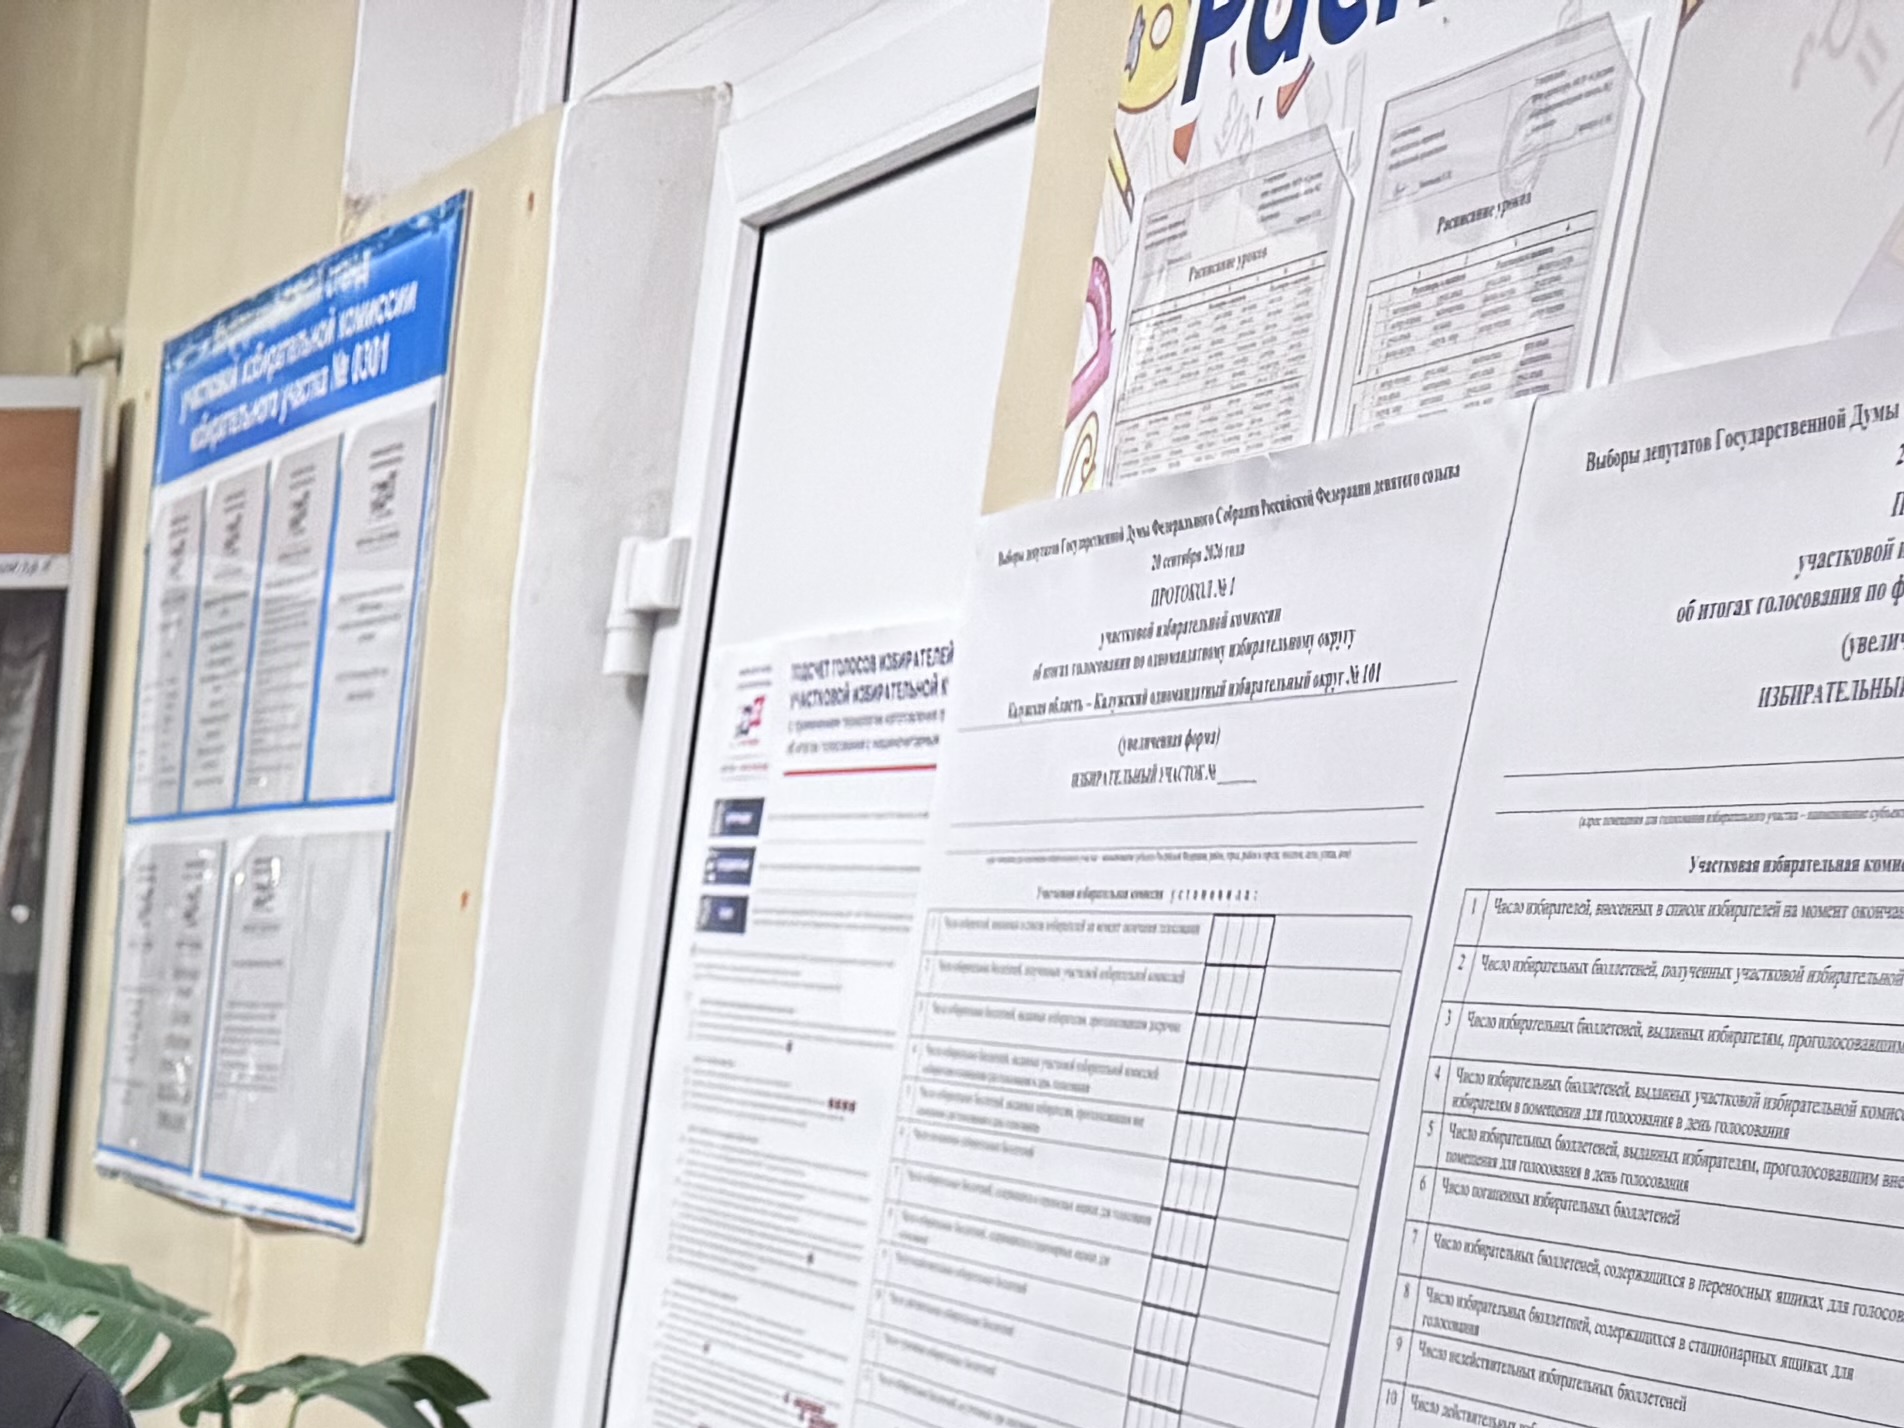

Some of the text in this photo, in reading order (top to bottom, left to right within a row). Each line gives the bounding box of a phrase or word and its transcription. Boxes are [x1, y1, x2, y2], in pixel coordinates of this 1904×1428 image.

[329, 347, 349, 391] №
[350, 330, 390, 385] 0301
[1585, 402, 1899, 472] Выборы депутатов Государственной Думы
[1794, 536, 1895, 579] участковой
[1676, 582, 1887, 623] об итогах голосования по
[1688, 854, 1860, 878] Участковая избирательная
[1433, 1231, 1462, 1251] Число
[1687, 1277, 1695, 1290] в
[1697, 1278, 1772, 1302] переносных
[1775, 1290, 1824, 1310] ящиках
[1826, 1298, 1850, 1314] для
